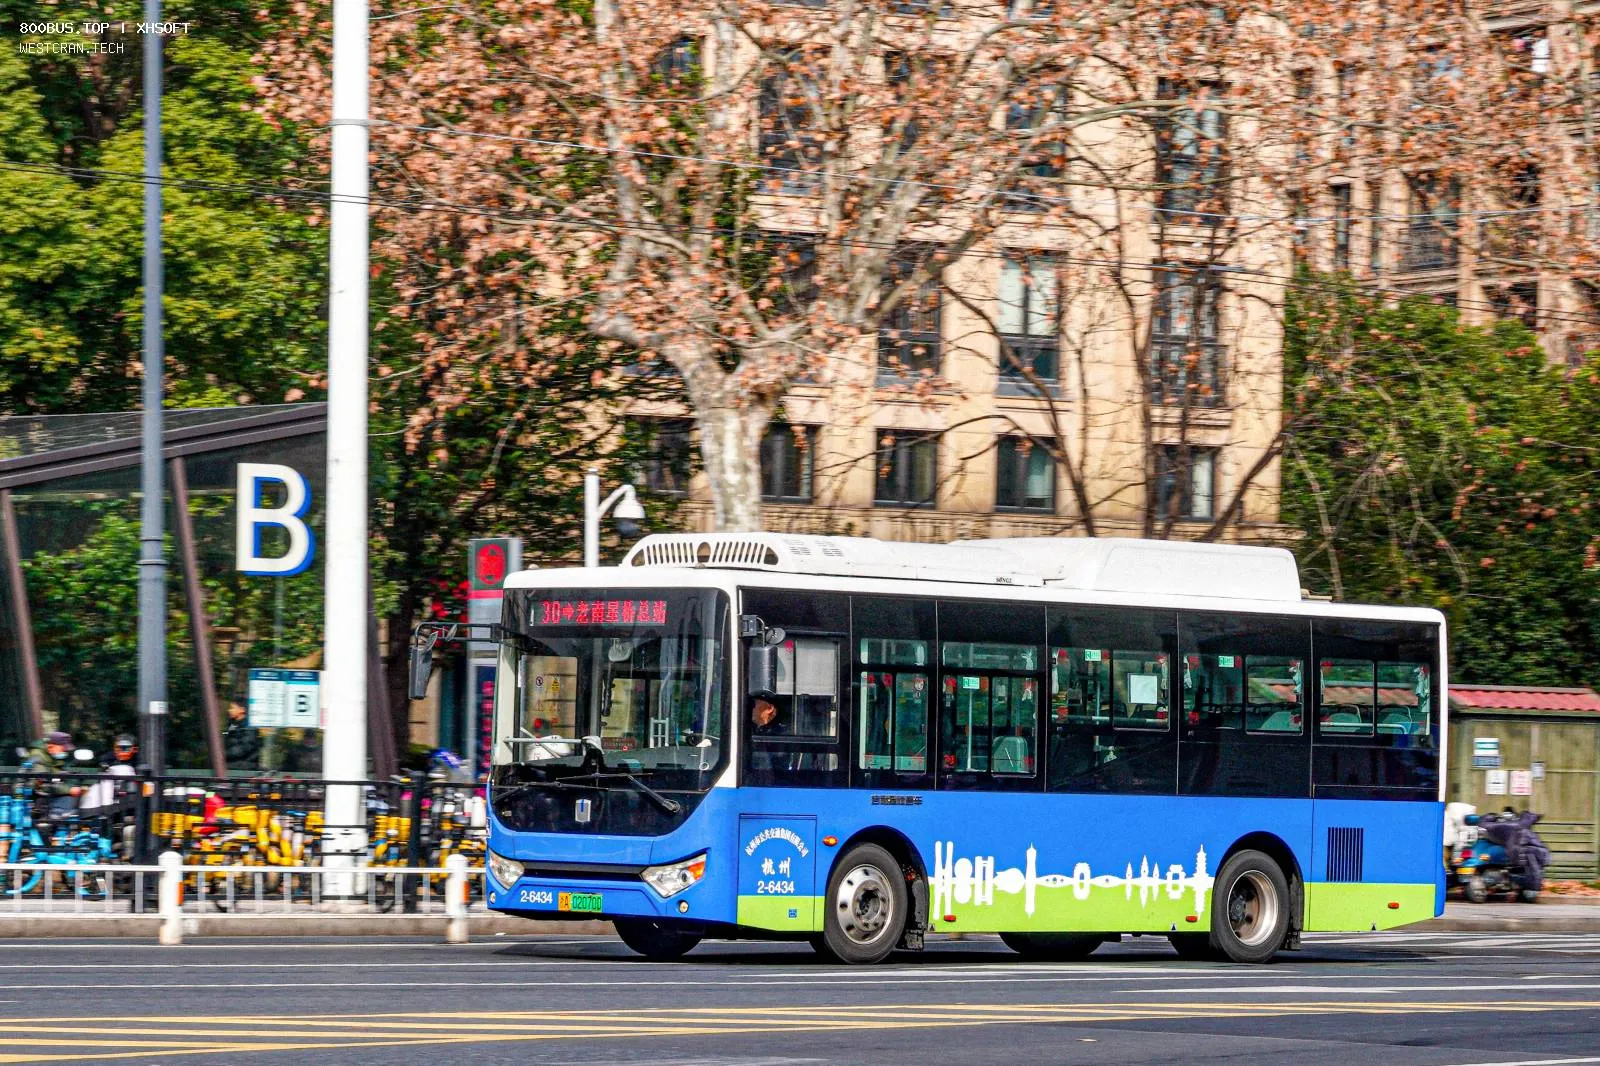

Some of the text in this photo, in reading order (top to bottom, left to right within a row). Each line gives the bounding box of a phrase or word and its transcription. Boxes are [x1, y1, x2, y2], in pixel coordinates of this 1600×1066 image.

[236, 463, 314, 575] B
[542, 600, 560, 624] 30
[761, 857, 791, 878] 杭州
[520, 890, 553, 904] 2-6434
[757, 880, 795, 894] 2-6434
